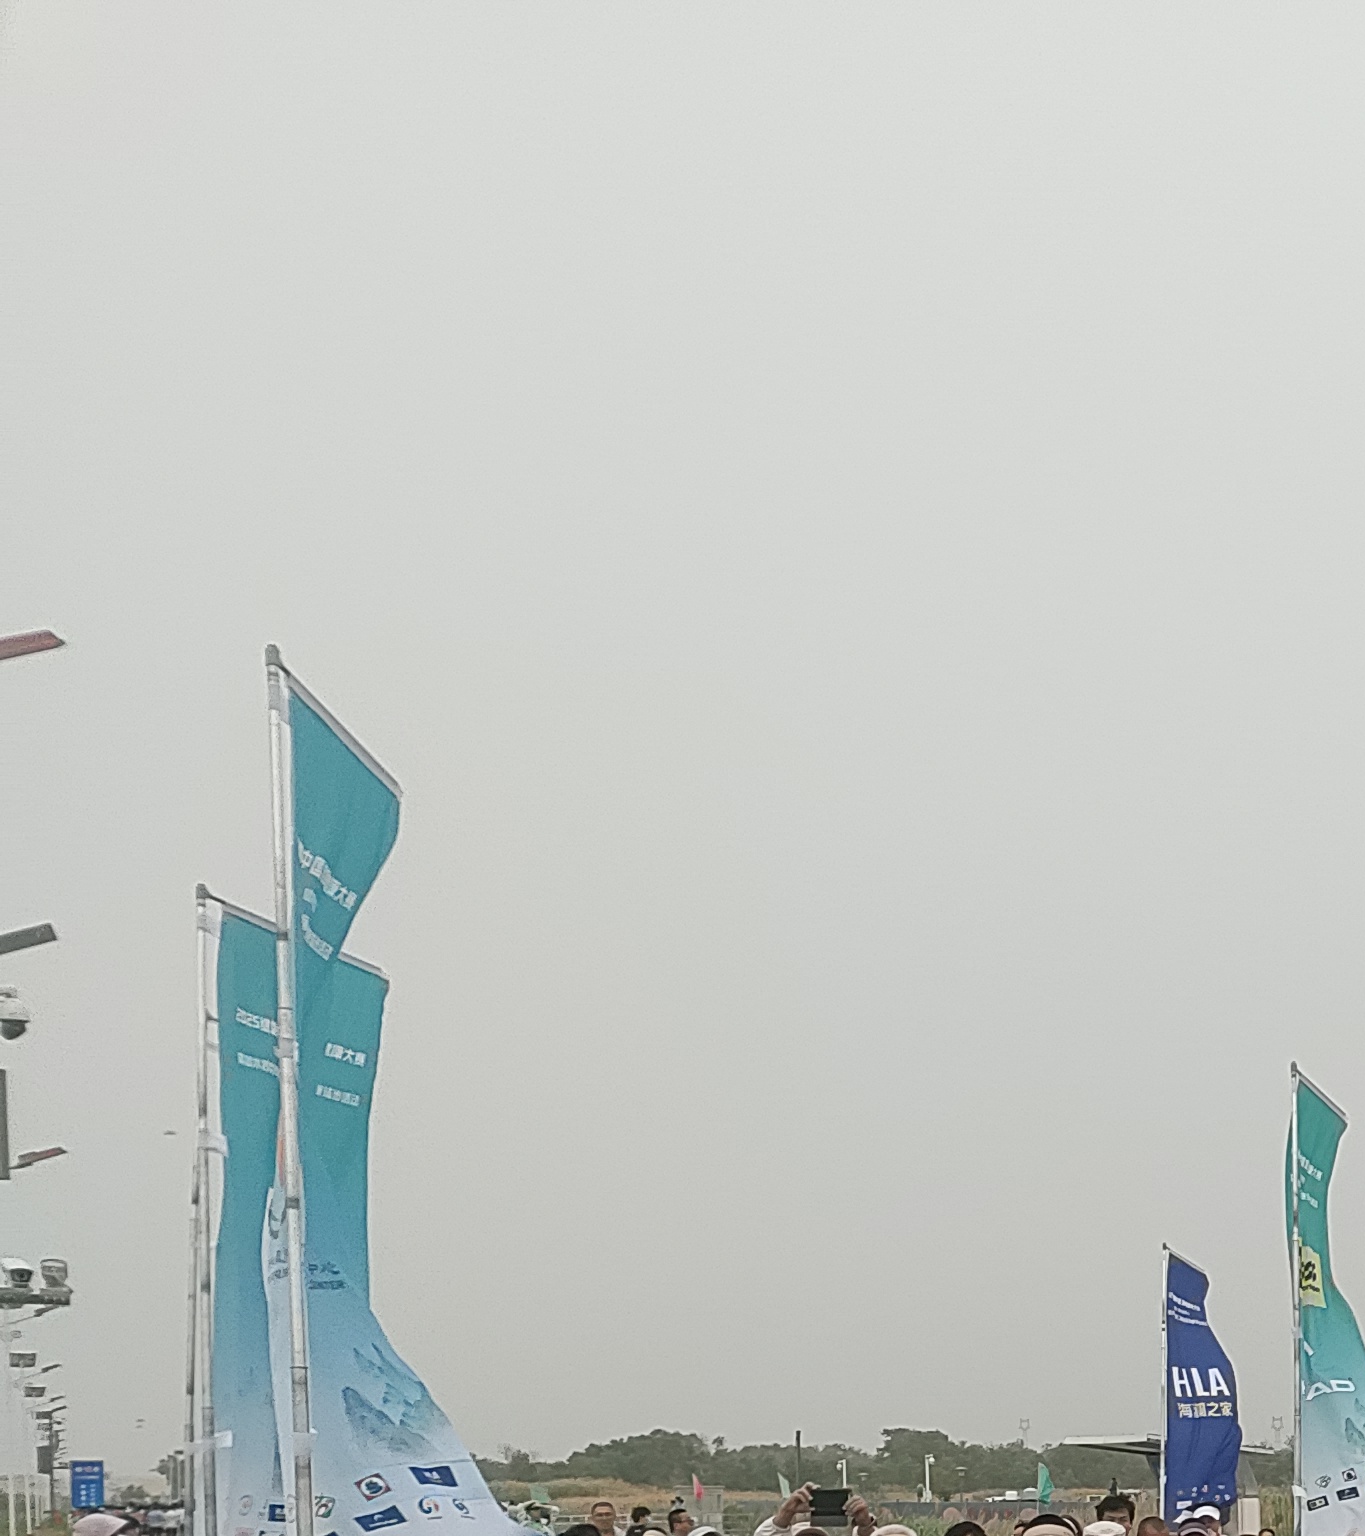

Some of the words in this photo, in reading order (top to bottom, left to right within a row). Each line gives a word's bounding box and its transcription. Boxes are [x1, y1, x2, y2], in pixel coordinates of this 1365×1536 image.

[1171, 1366, 1231, 1398] HLA
[1177, 1402, 1234, 1418] 海澜之家
